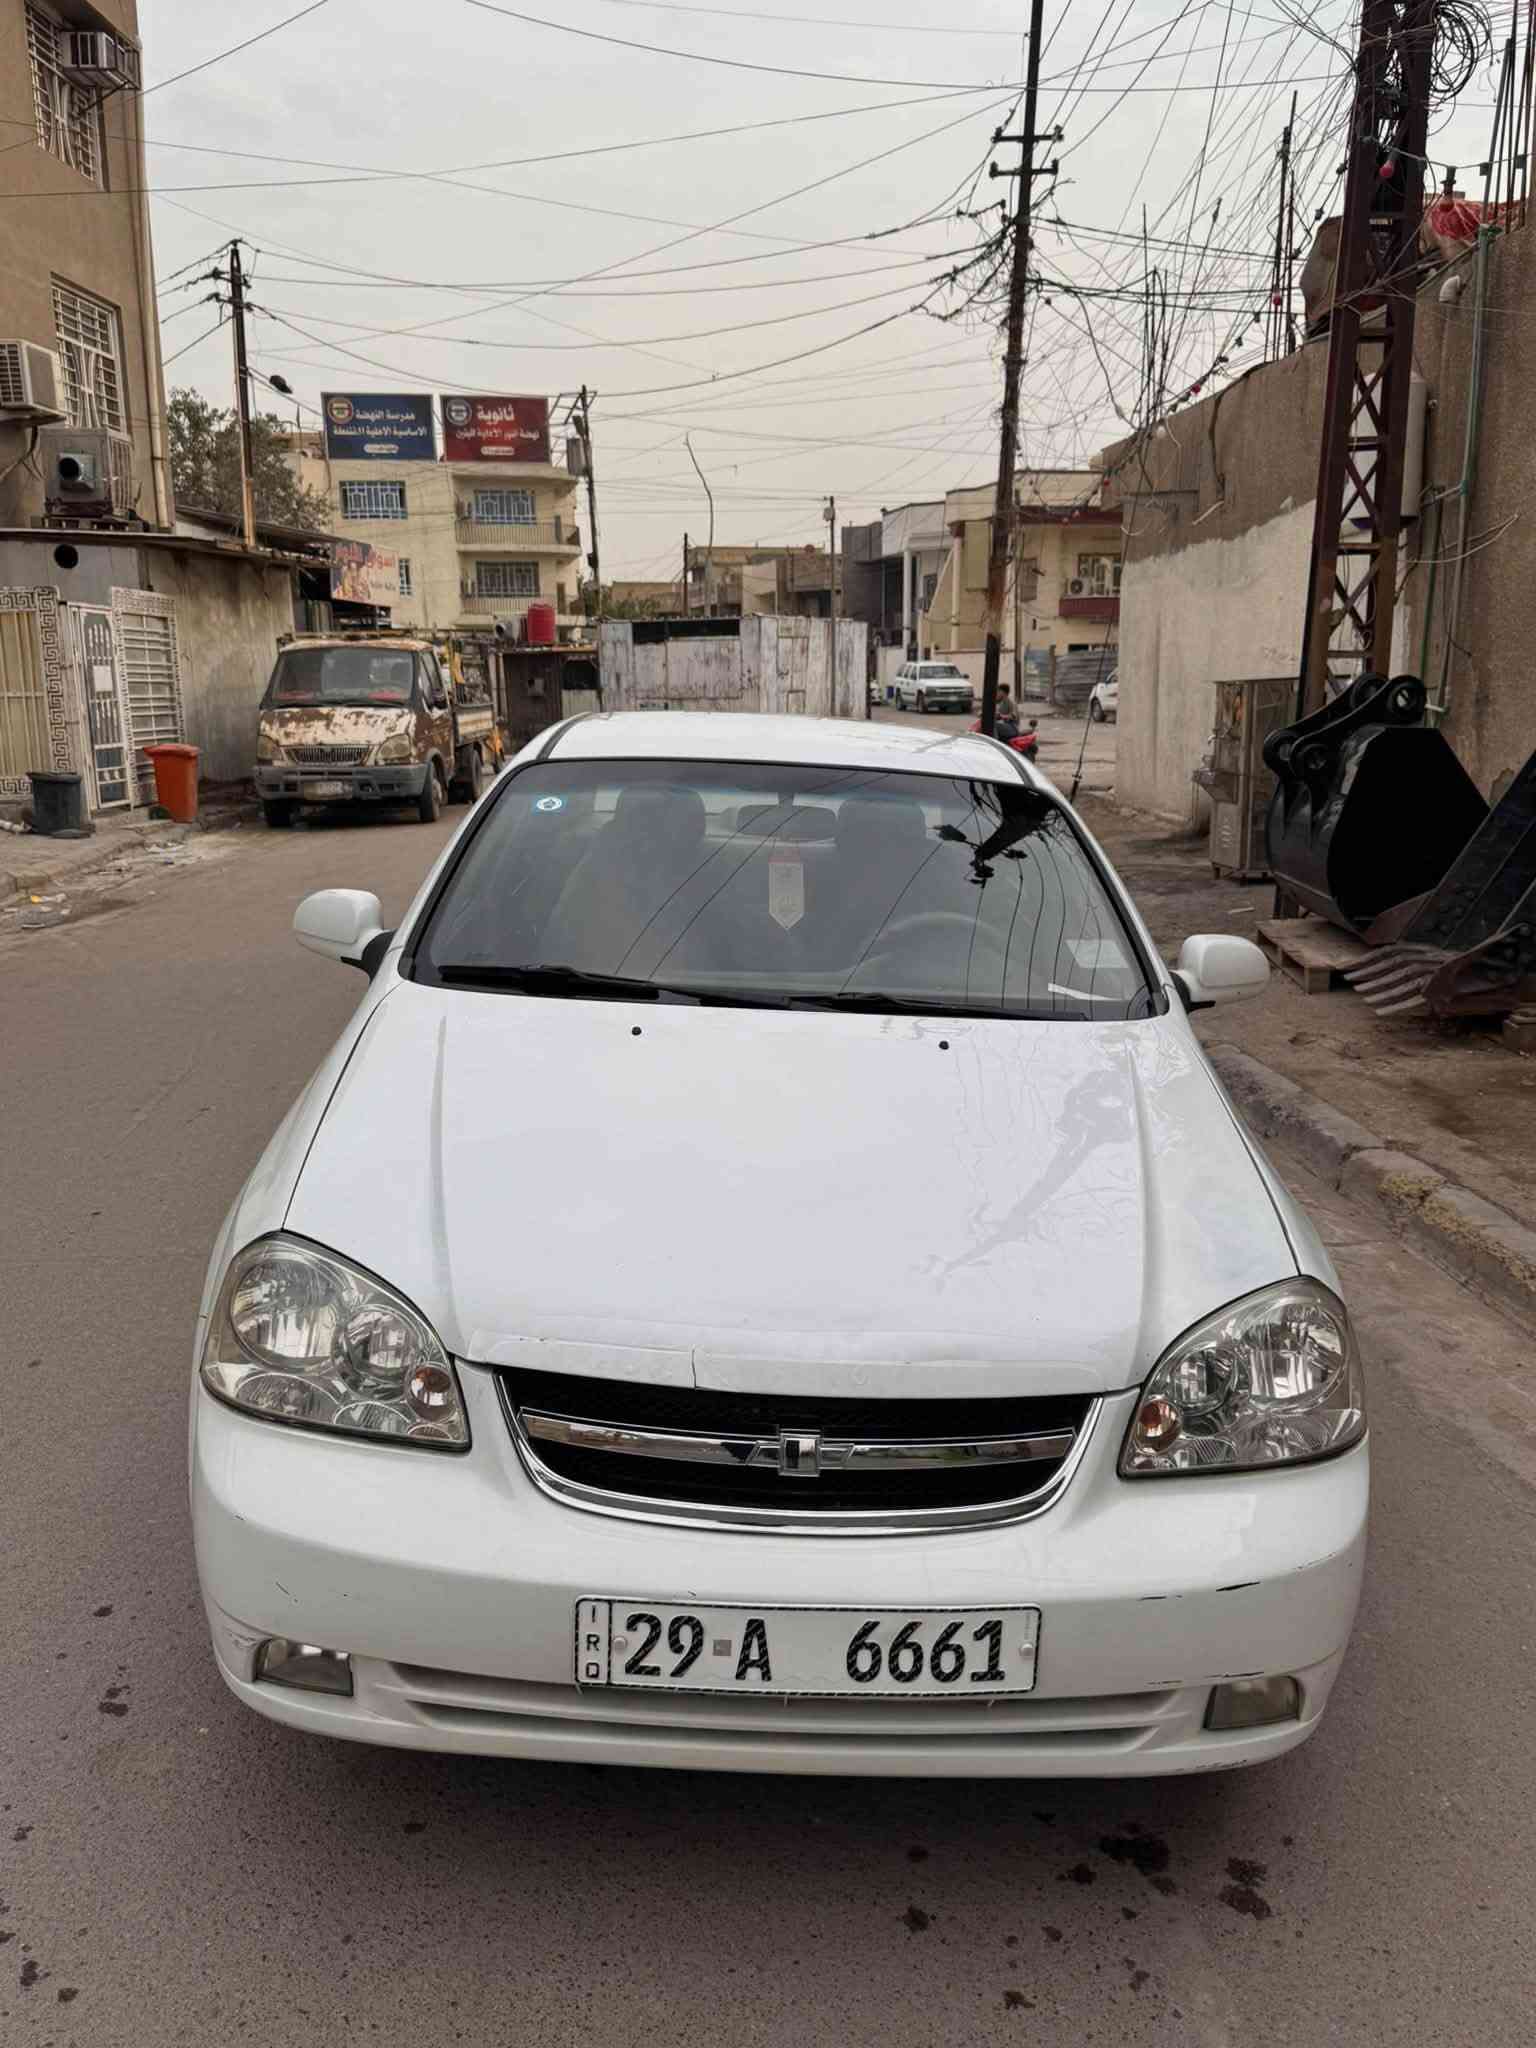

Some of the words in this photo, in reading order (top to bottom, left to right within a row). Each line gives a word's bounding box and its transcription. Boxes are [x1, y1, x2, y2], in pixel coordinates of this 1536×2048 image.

[386, 408, 416, 423] مدرسة
[477, 404, 514, 425] ثانوية
[624, 1613, 705, 1678] 29
[735, 1618, 772, 1682] A
[846, 1619, 1006, 1684] 6661
